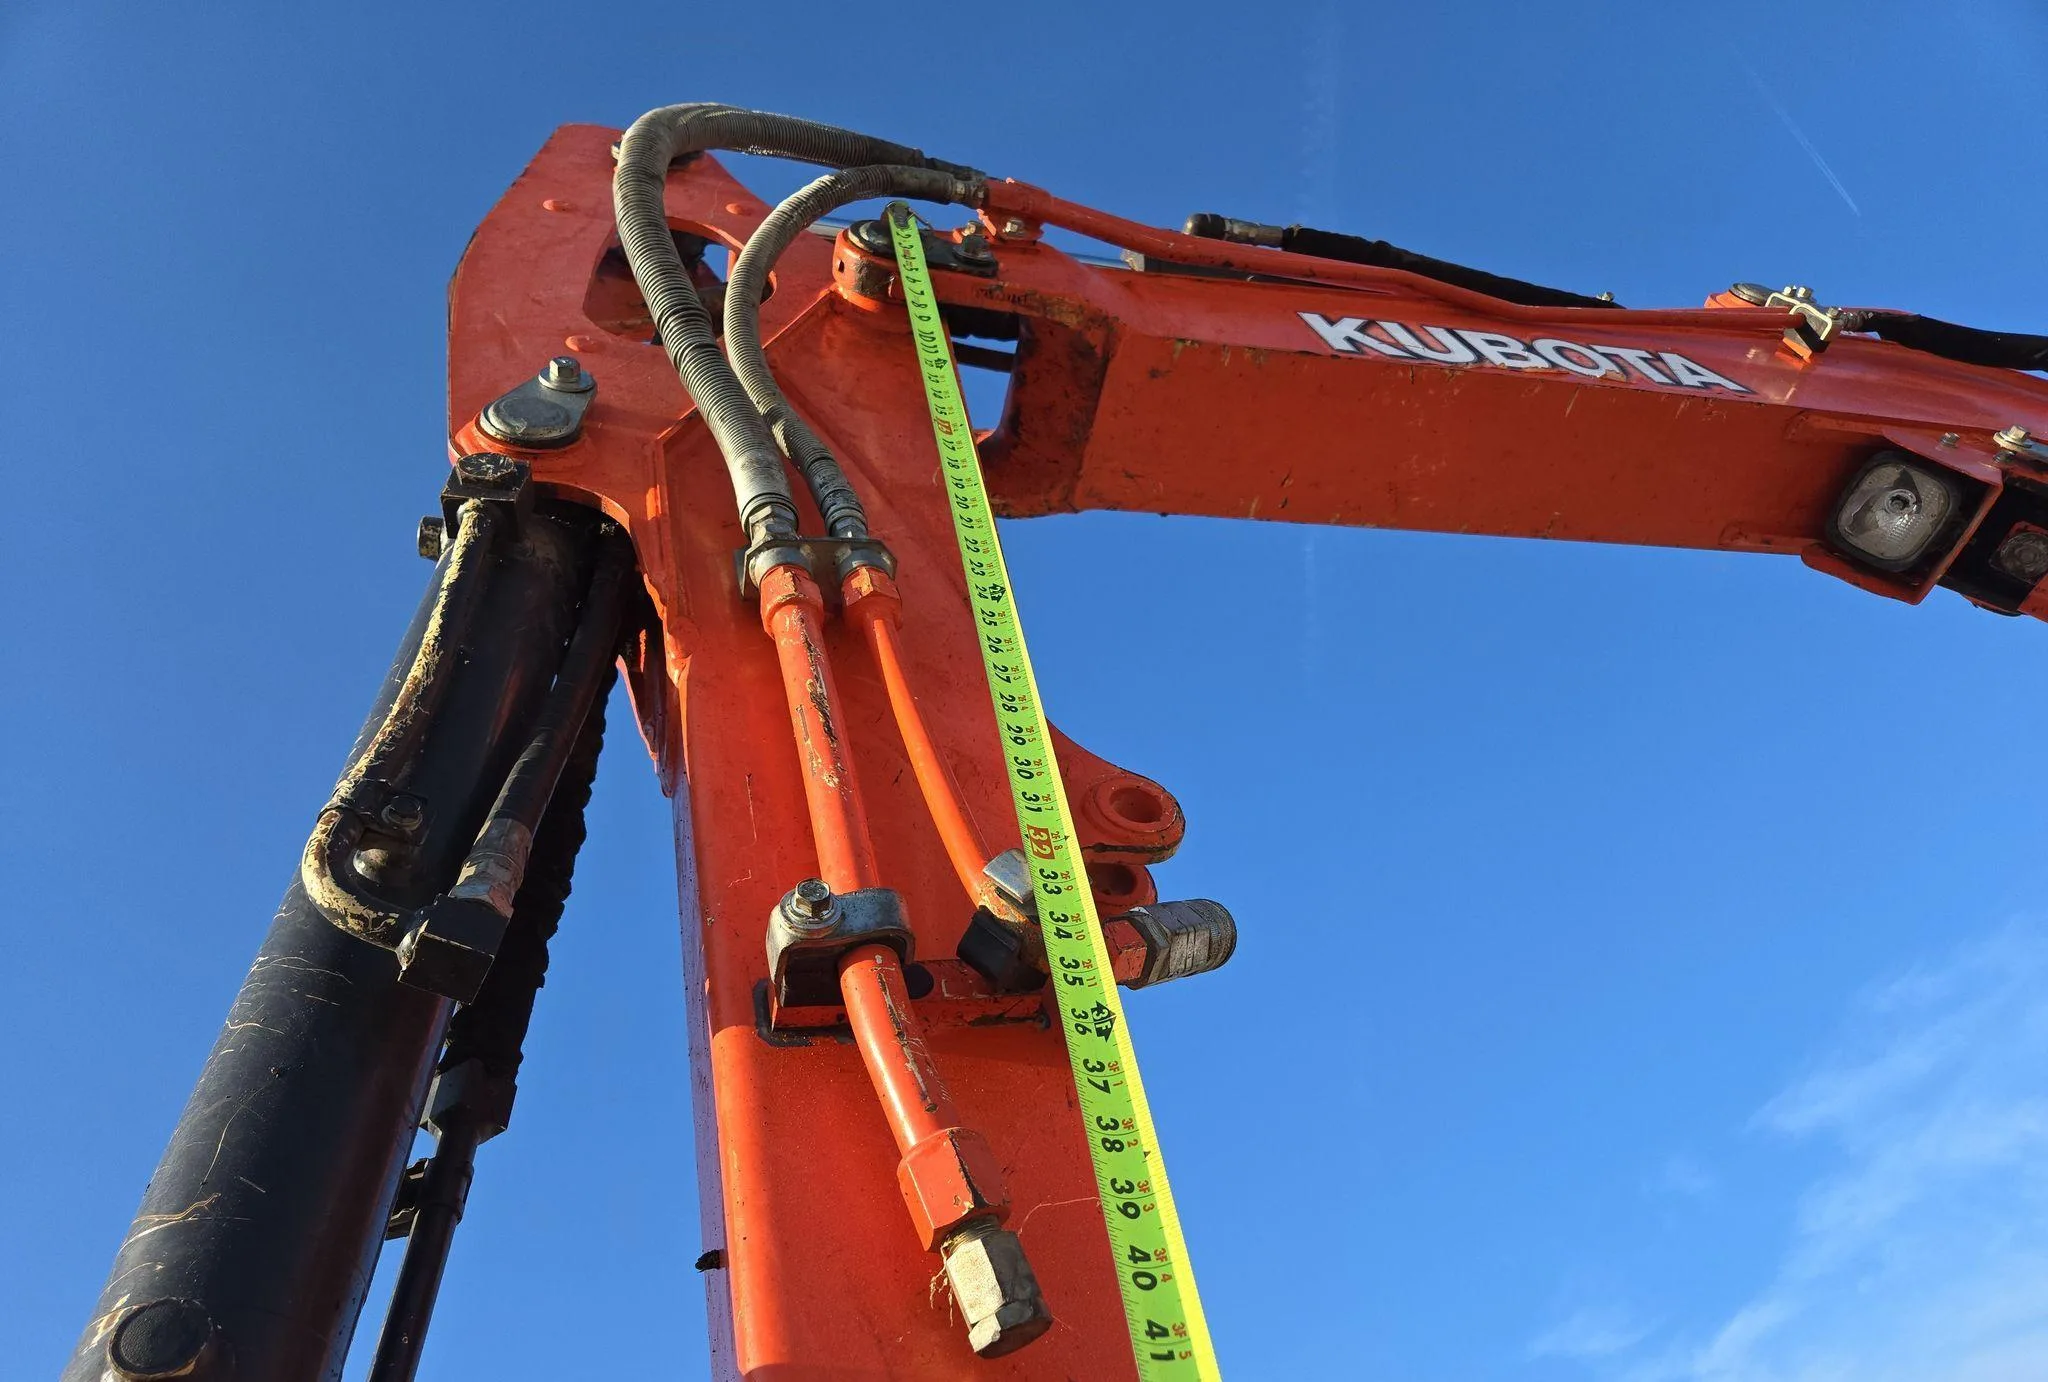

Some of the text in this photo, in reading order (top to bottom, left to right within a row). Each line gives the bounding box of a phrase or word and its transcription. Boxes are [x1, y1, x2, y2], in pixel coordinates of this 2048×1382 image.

[911, 300, 928, 309] 8
[914, 313, 932, 321] 9
[918, 329, 937, 342] 10
[1297, 311, 1757, 395] KUBOTA
[946, 456, 960, 470] 18
[950, 475, 965, 489] 19
[954, 493, 970, 509] 20
[959, 513, 974, 529] 21
[964, 535, 980, 553] 22
[969, 558, 986, 576] 23
[974, 584, 989, 600] 24
[980, 607, 998, 626] 25
[986, 634, 1004, 654] 26
[992, 662, 1011, 684] 27
[999, 691, 1018, 713] 28
[1006, 722, 1026, 746] 29
[1013, 756, 1035, 780] 30
[1021, 791, 1043, 812] 31
[1028, 828, 1052, 855] 32
[1039, 868, 1062, 895] 33
[1049, 911, 1073, 940] 34
[1074, 929, 1086, 941] 10
[1059, 956, 1084, 986] 35
[1082, 959, 1098, 988] 2F 11
[1070, 1007, 1092, 1036] 36
[1092, 1008, 1109, 1032] 3F
[1082, 1058, 1111, 1094] 37
[1107, 1060, 1121, 1073] 3F
[1095, 1115, 1125, 1153] 38
[1121, 1118, 1139, 1147] 3F 2
[1109, 1177, 1141, 1220] 39
[1137, 1179, 1155, 1212] 3F 3
[1127, 1244, 1157, 1291] 40
[1153, 1247, 1172, 1283] 3F 4
[1144, 1319, 1176, 1362] 41
[1171, 1322, 1192, 1360] 3F 5
